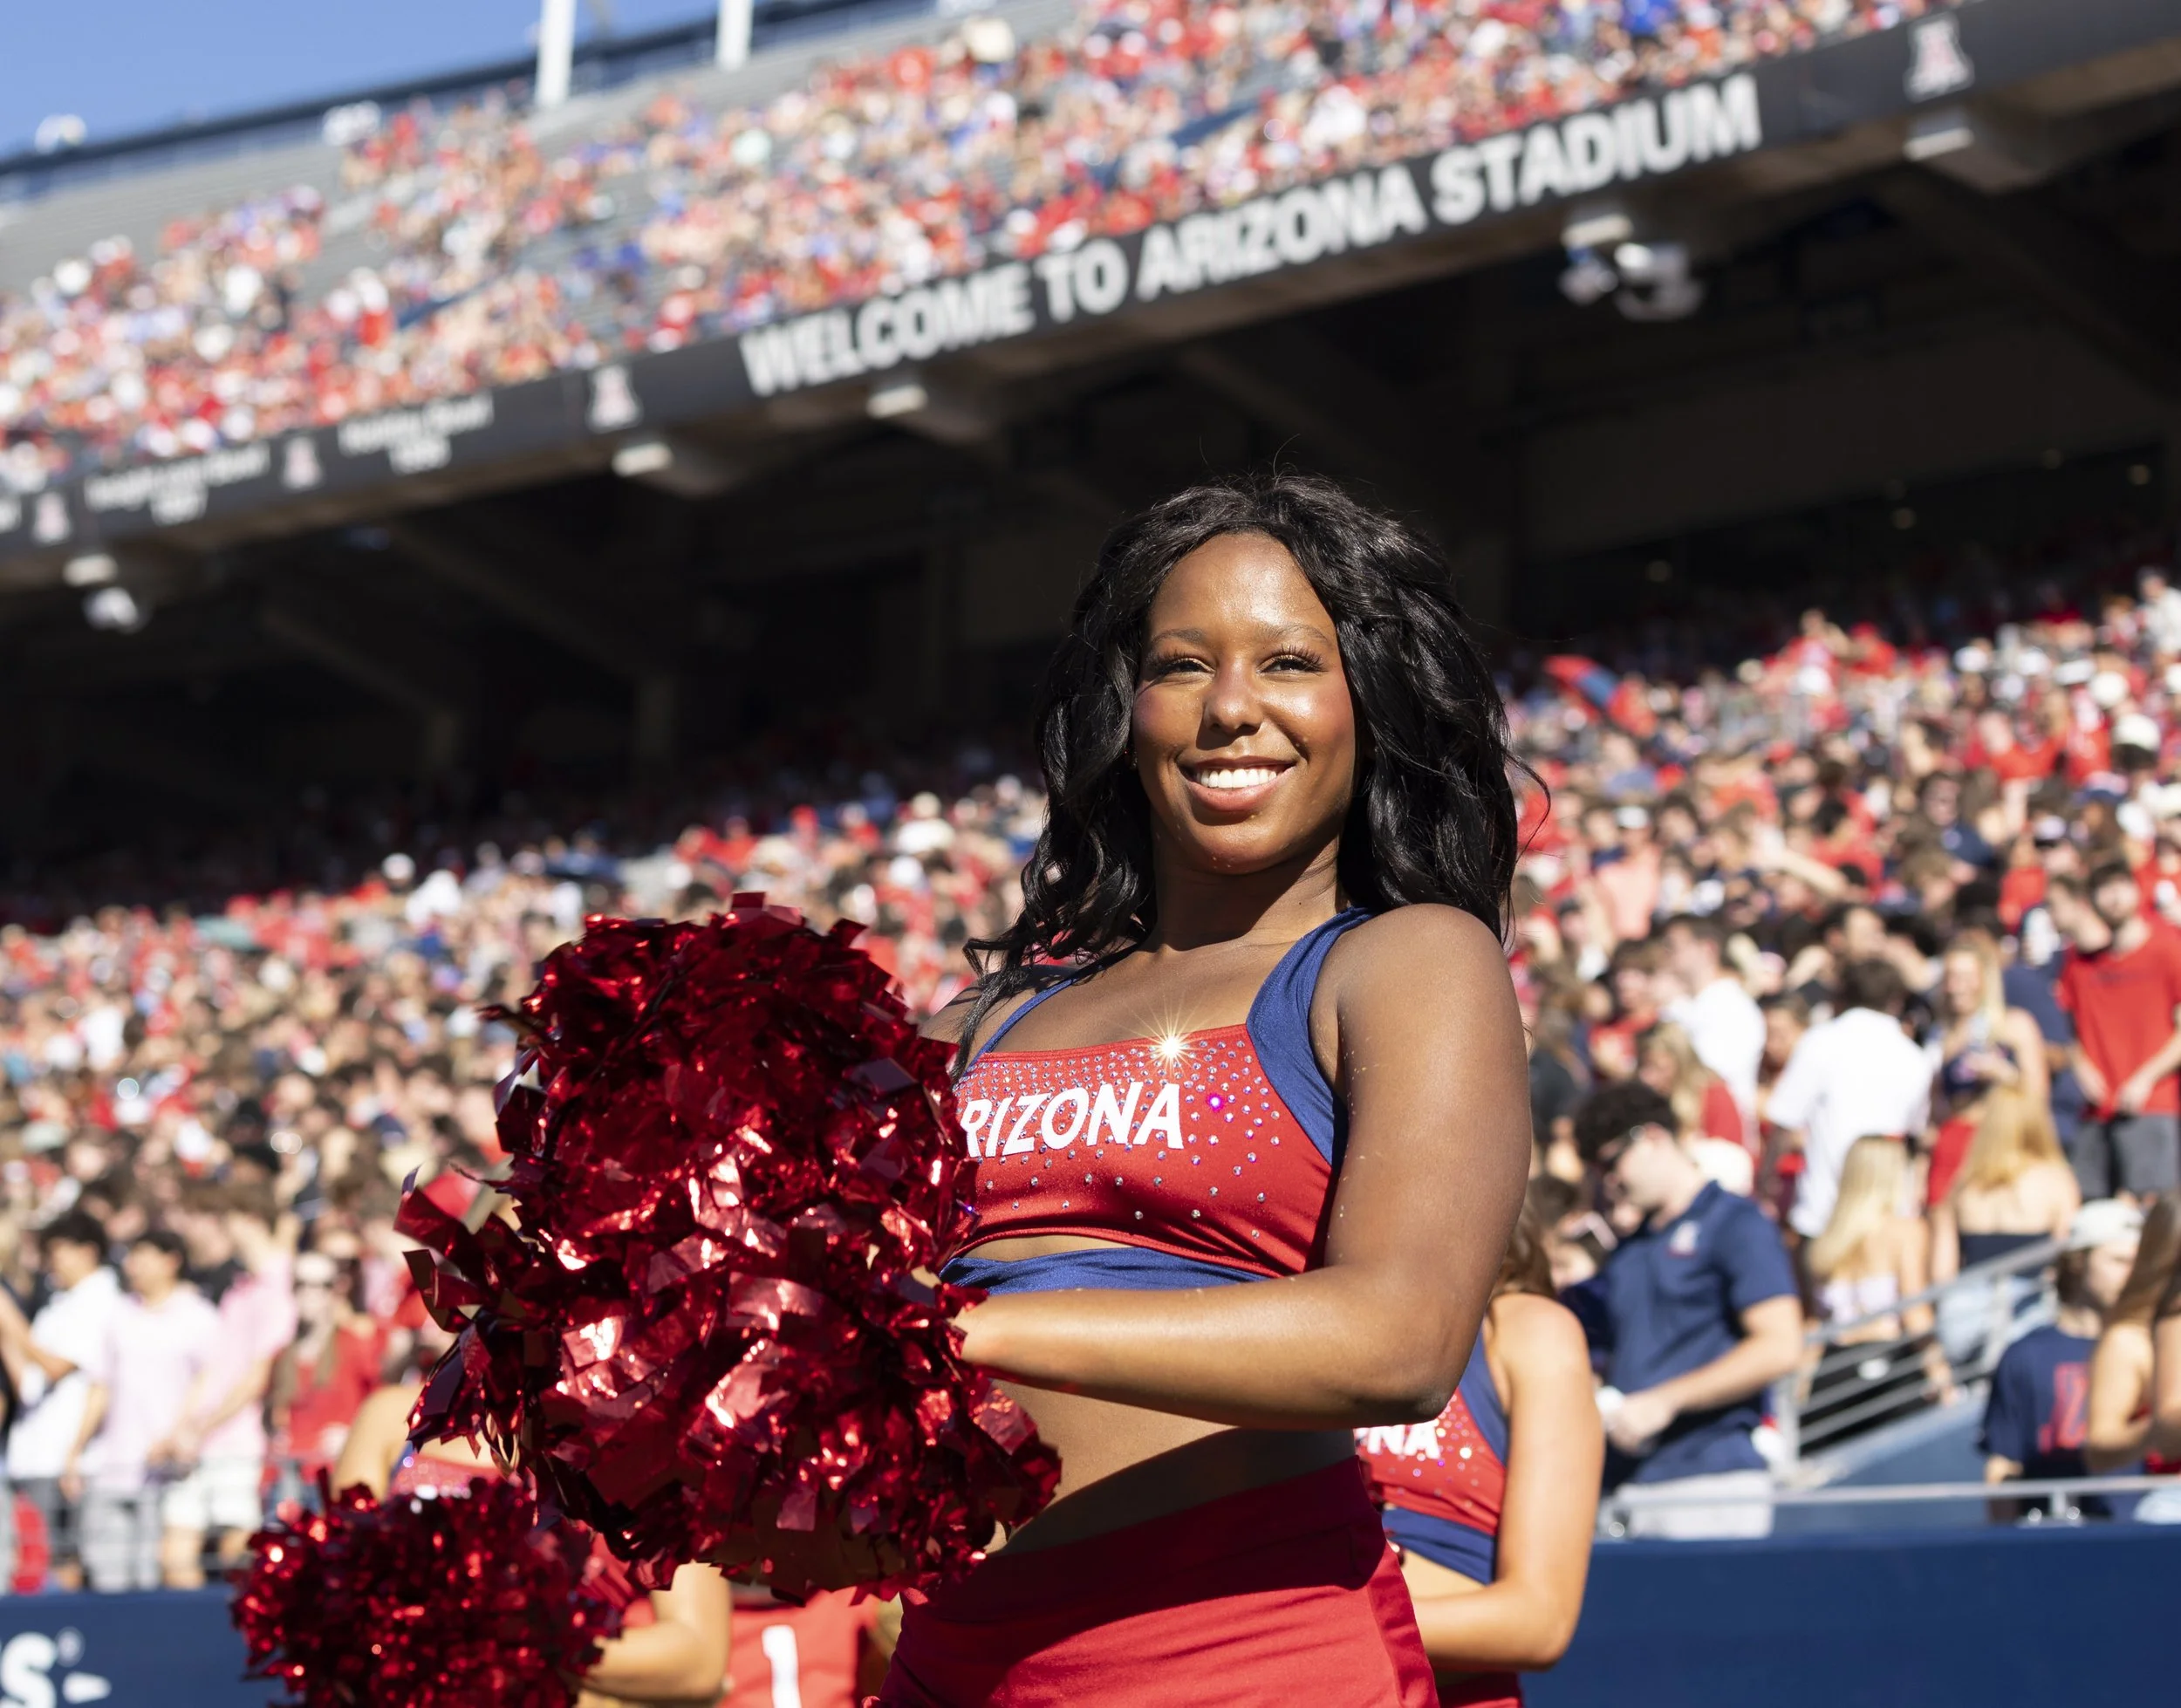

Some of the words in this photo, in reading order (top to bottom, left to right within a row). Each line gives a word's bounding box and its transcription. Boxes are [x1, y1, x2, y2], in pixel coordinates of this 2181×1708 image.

[740, 262, 1036, 397] WELCOME
[1035, 238, 1130, 322] TO
[1136, 164, 1428, 302] ARIZONA
[1430, 73, 1762, 225] STADIUM
[959, 1082, 1185, 1158] RIZONA
[1353, 1418, 1441, 1459] NA
